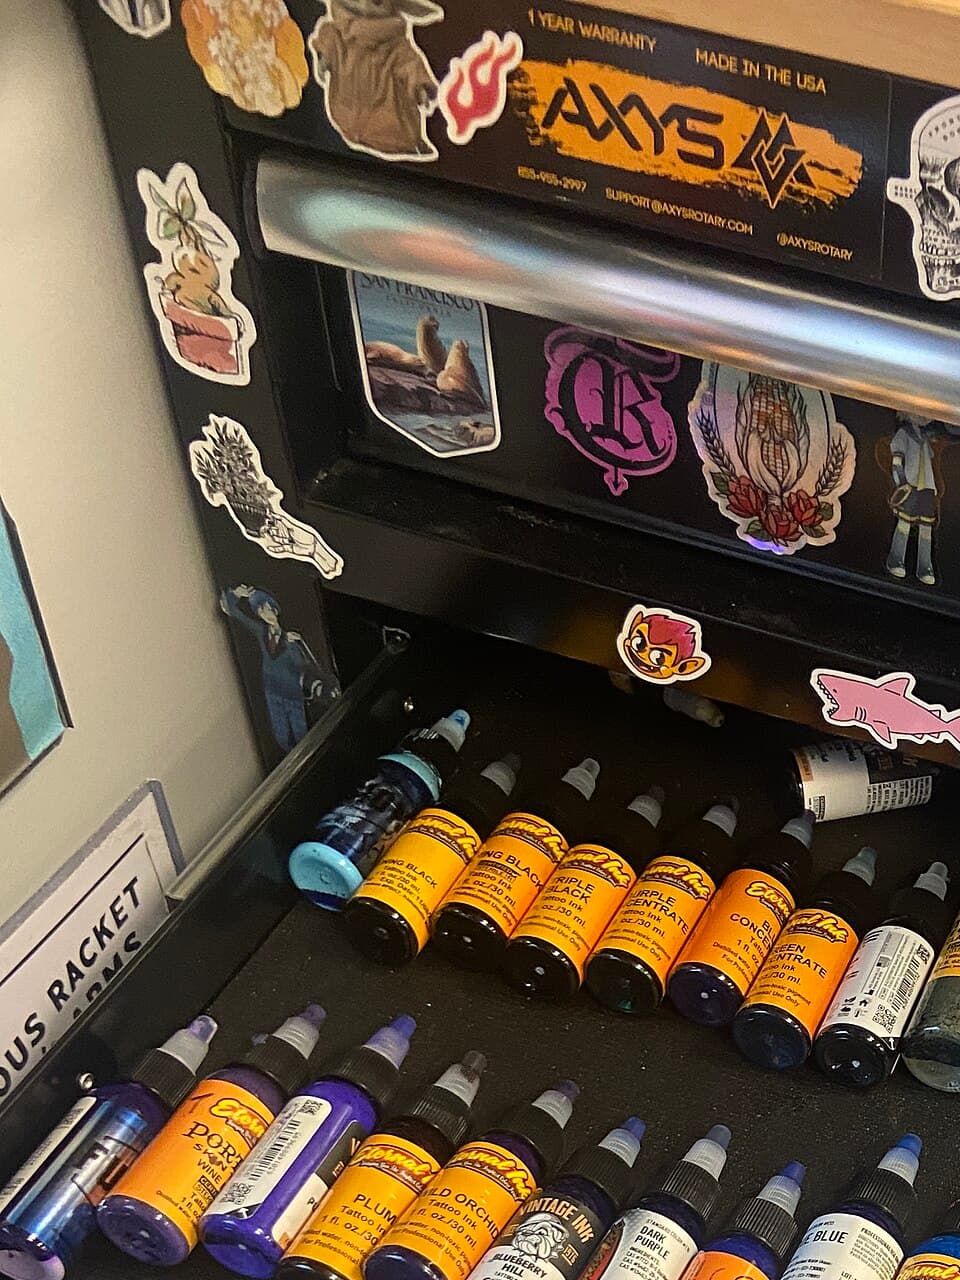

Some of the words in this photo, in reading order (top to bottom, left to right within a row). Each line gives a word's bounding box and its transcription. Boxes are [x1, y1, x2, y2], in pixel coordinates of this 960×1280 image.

[537, 11, 576, 36] YEAR
[579, 20, 657, 54] WARRANTY
[696, 47, 738, 74] MADE
[743, 59, 761, 78] IN
[765, 63, 792, 87] THE
[796, 71, 828, 96] USA
[541, 77, 724, 170] AXYS
[776, 232, 853, 262] @AXYSROTARY
[406, 863, 438, 890] BLACK
[505, 853, 544, 891] BLACK
[47, 876, 140, 1013] RACKET
[196, 1159, 222, 1185] WINE
[340, 1205, 376, 1227] Tattoo
[353, 1193, 399, 1226] PLUM
[427, 1198, 462, 1219] Tattoo
[462, 1215, 478, 1231] Ink
[455, 1193, 500, 1241] ORCHID
[518, 1196, 573, 1223] VINTAGE
[571, 1213, 596, 1245] INK
[634, 1234, 671, 1261] PURPLE
[639, 1225, 668, 1244] DARK
[814, 1230, 848, 1246] BLUE
[493, 1253, 549, 1280] BLUEBERRY
[500, 1262, 525, 1279] HILL
